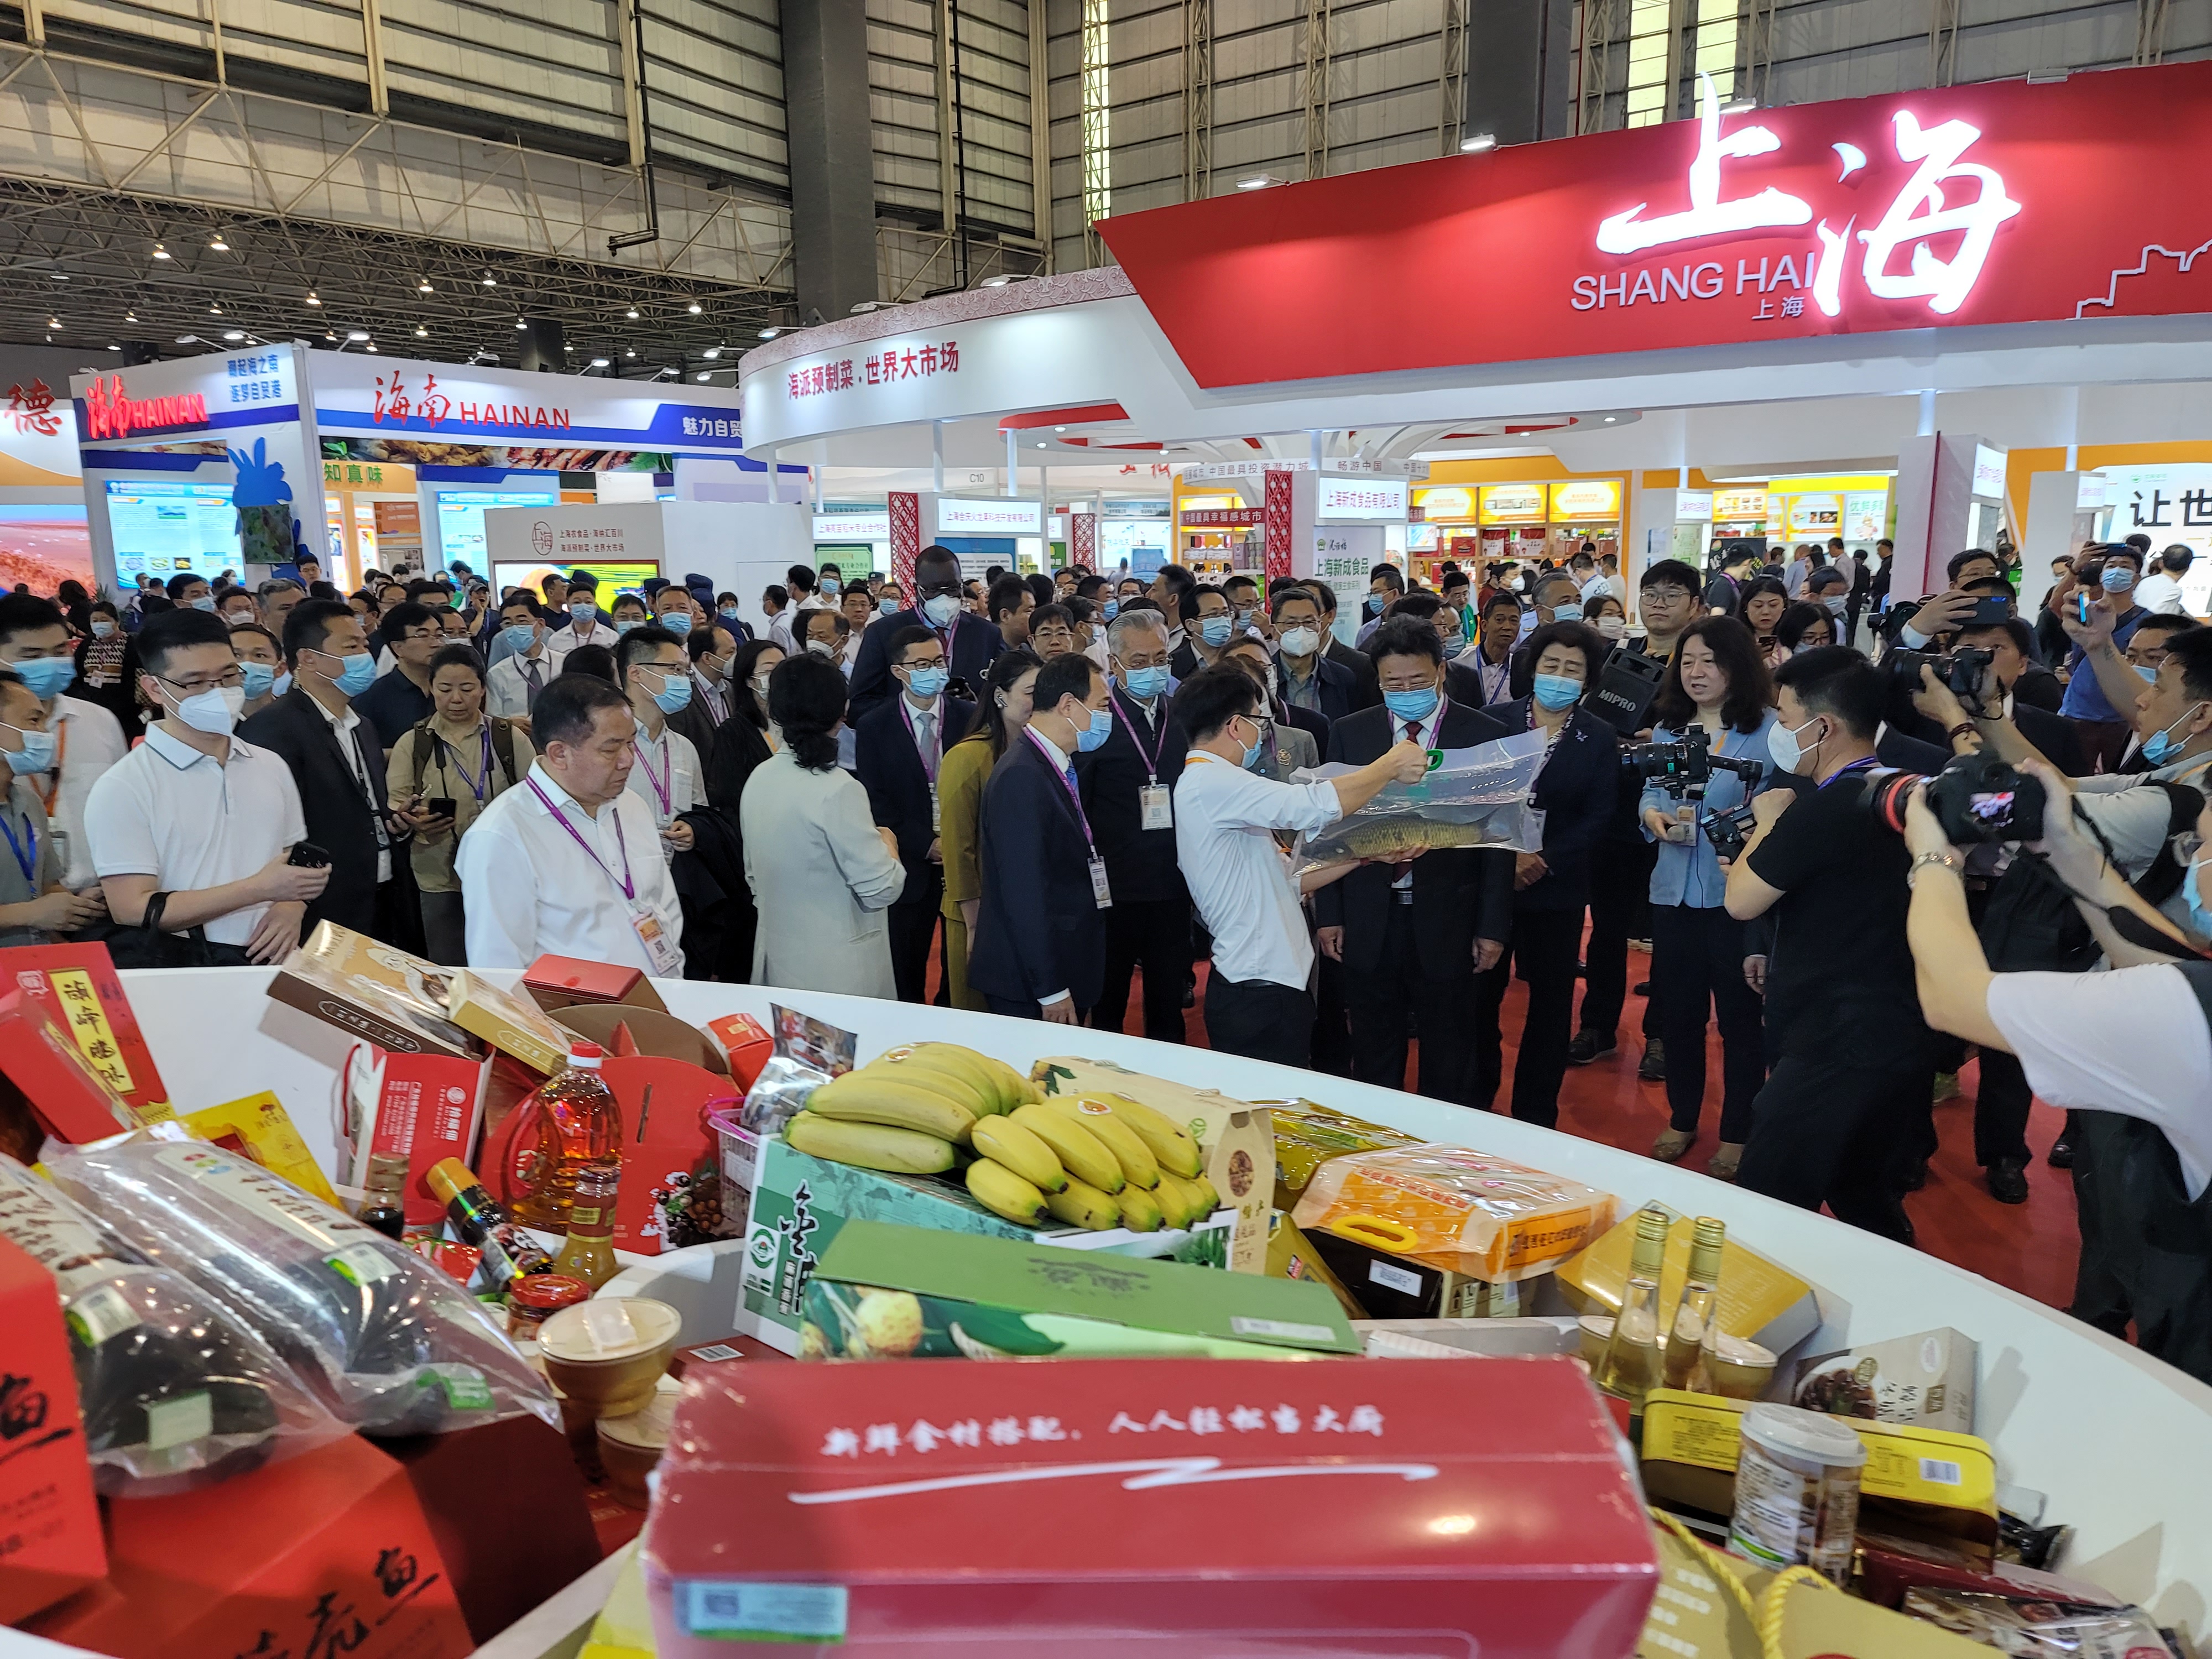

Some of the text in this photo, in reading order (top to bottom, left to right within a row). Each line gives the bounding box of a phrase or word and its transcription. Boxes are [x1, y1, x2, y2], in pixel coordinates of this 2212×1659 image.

[1596, 71, 2022, 317] 上海
[1571, 252, 1814, 311] SHANG HAI
[1752, 296, 1804, 321] 上海
[4, 377, 62, 436] 德
[87, 376, 133, 440] 海南
[133, 393, 208, 429] HAINAN
[373, 371, 451, 429] 海南
[460, 401, 570, 430] HAINAN
[682, 417, 743, 439] 魅力自贸
[324, 462, 383, 483] 知真味
[970, 473, 984, 483] C10
[1338, 461, 1382, 471] 畅游中国
[1314, 557, 1369, 577] 上海新成食品
[1598, 689, 1637, 712] MIPRO
